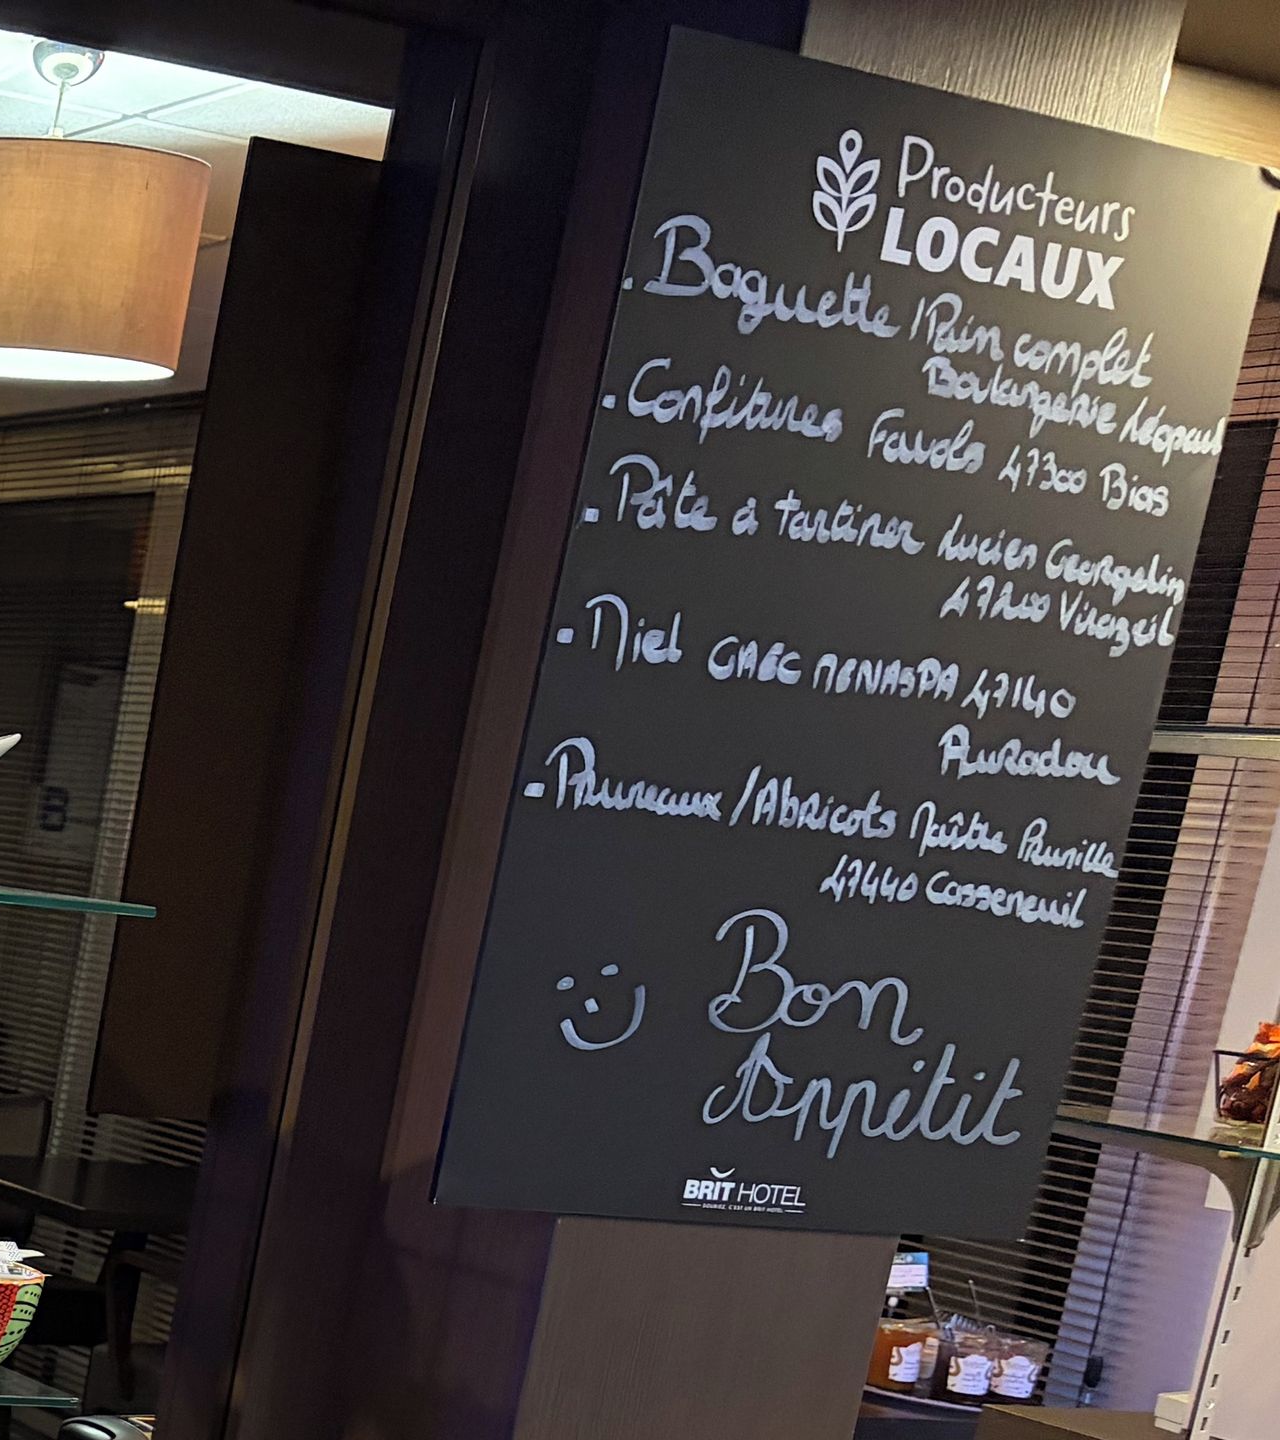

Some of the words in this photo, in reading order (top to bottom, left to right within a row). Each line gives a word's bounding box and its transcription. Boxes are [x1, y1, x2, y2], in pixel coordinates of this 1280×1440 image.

[898, 135, 1135, 242] Producteurs
[643, 214, 901, 338] Baguette
[1013, 327, 1155, 398] complet
[880, 206, 1125, 310] LOCAUX
[628, 357, 843, 444] Confitures
[998, 444, 1088, 493] 47300
[960, 668, 1077, 719] 47140
[819, 854, 919, 904] 47440
[708, 908, 924, 1046] Bon
[702, 1031, 1023, 1160] Appétit
[683, 1179, 736, 1201] BRIT
[737, 1182, 806, 1206] HOTEL
